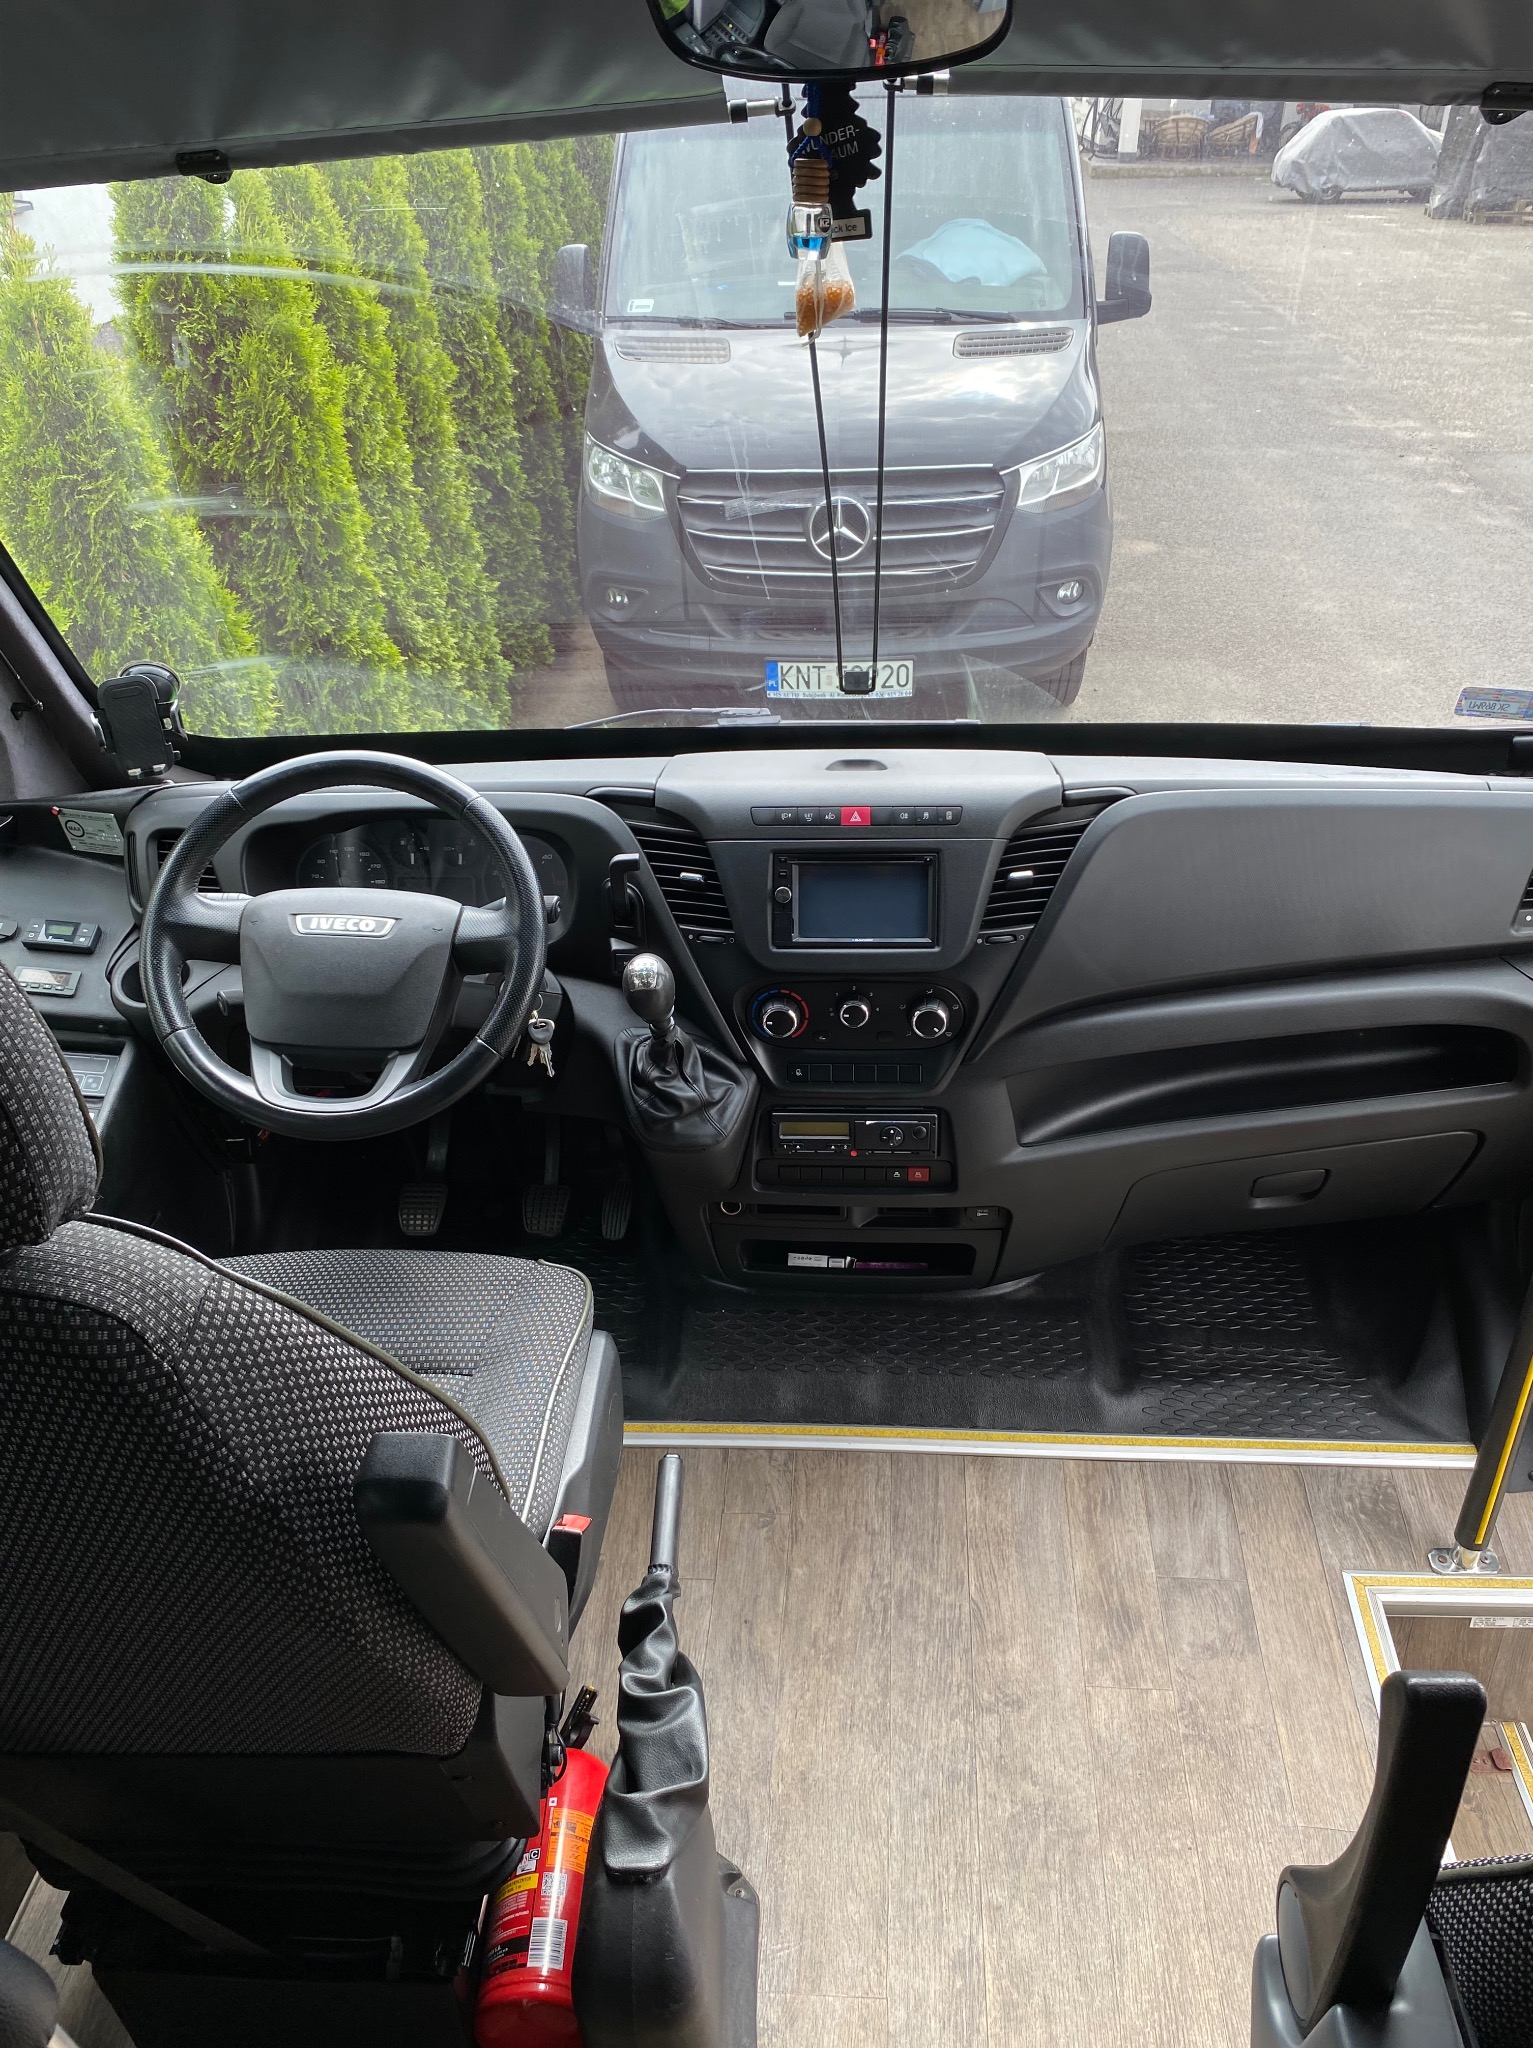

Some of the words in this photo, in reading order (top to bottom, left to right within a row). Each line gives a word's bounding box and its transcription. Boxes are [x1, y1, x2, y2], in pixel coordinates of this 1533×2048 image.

[819, 218, 830, 228] K2
[845, 223, 858, 232] Ice
[780, 664, 826, 690] KNT
[310, 917, 376, 932] IVECO
[531, 1849, 539, 1859] C
